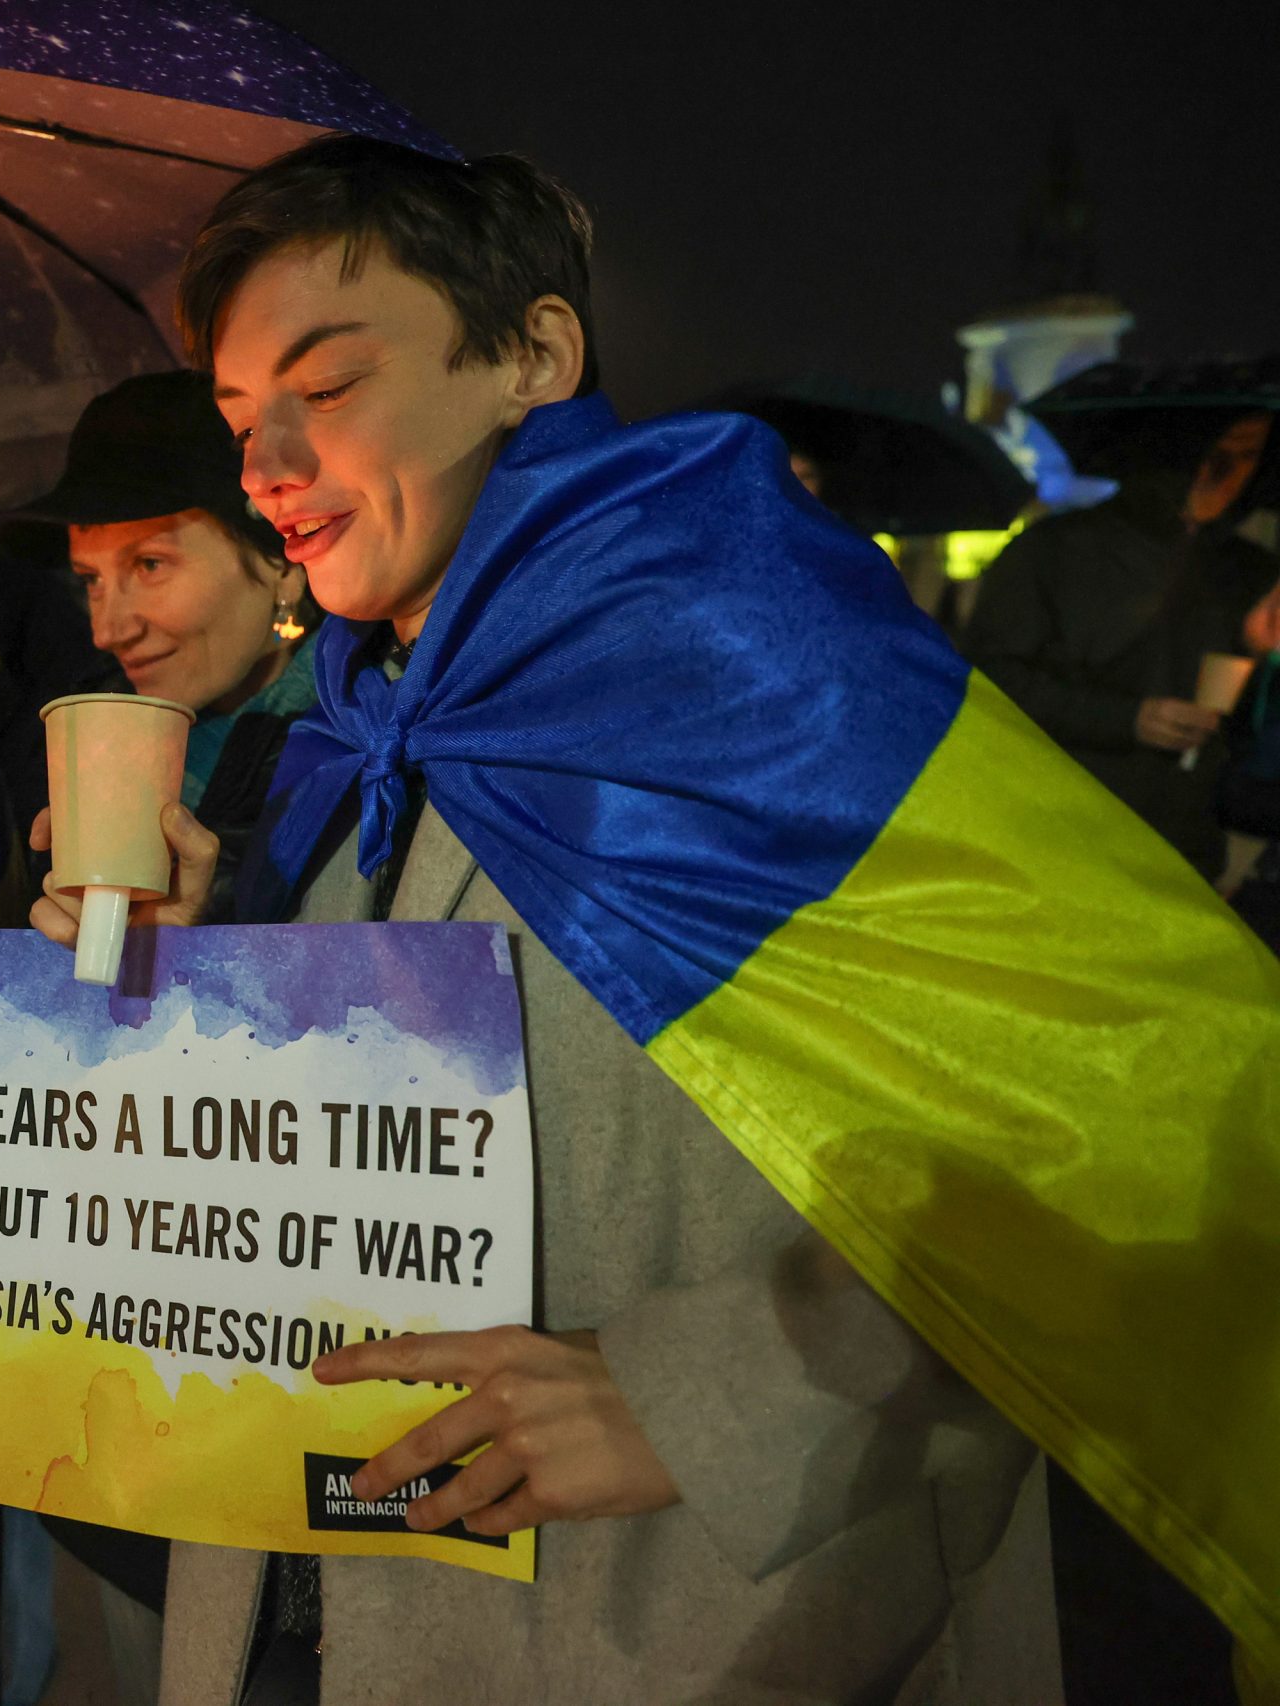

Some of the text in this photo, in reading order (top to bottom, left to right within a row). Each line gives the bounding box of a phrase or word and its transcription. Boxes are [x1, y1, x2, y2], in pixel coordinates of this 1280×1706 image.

[113, 1093, 144, 1155] A
[163, 1095, 299, 1166] LONG
[321, 1102, 495, 1178] TIME?
[64, 1191, 109, 1247] 10
[123, 1198, 261, 1263] YEARS
[278, 1212, 338, 1270] OF
[354, 1218, 494, 1288] WAR?
[84, 1291, 345, 1371] AGGRESSION
